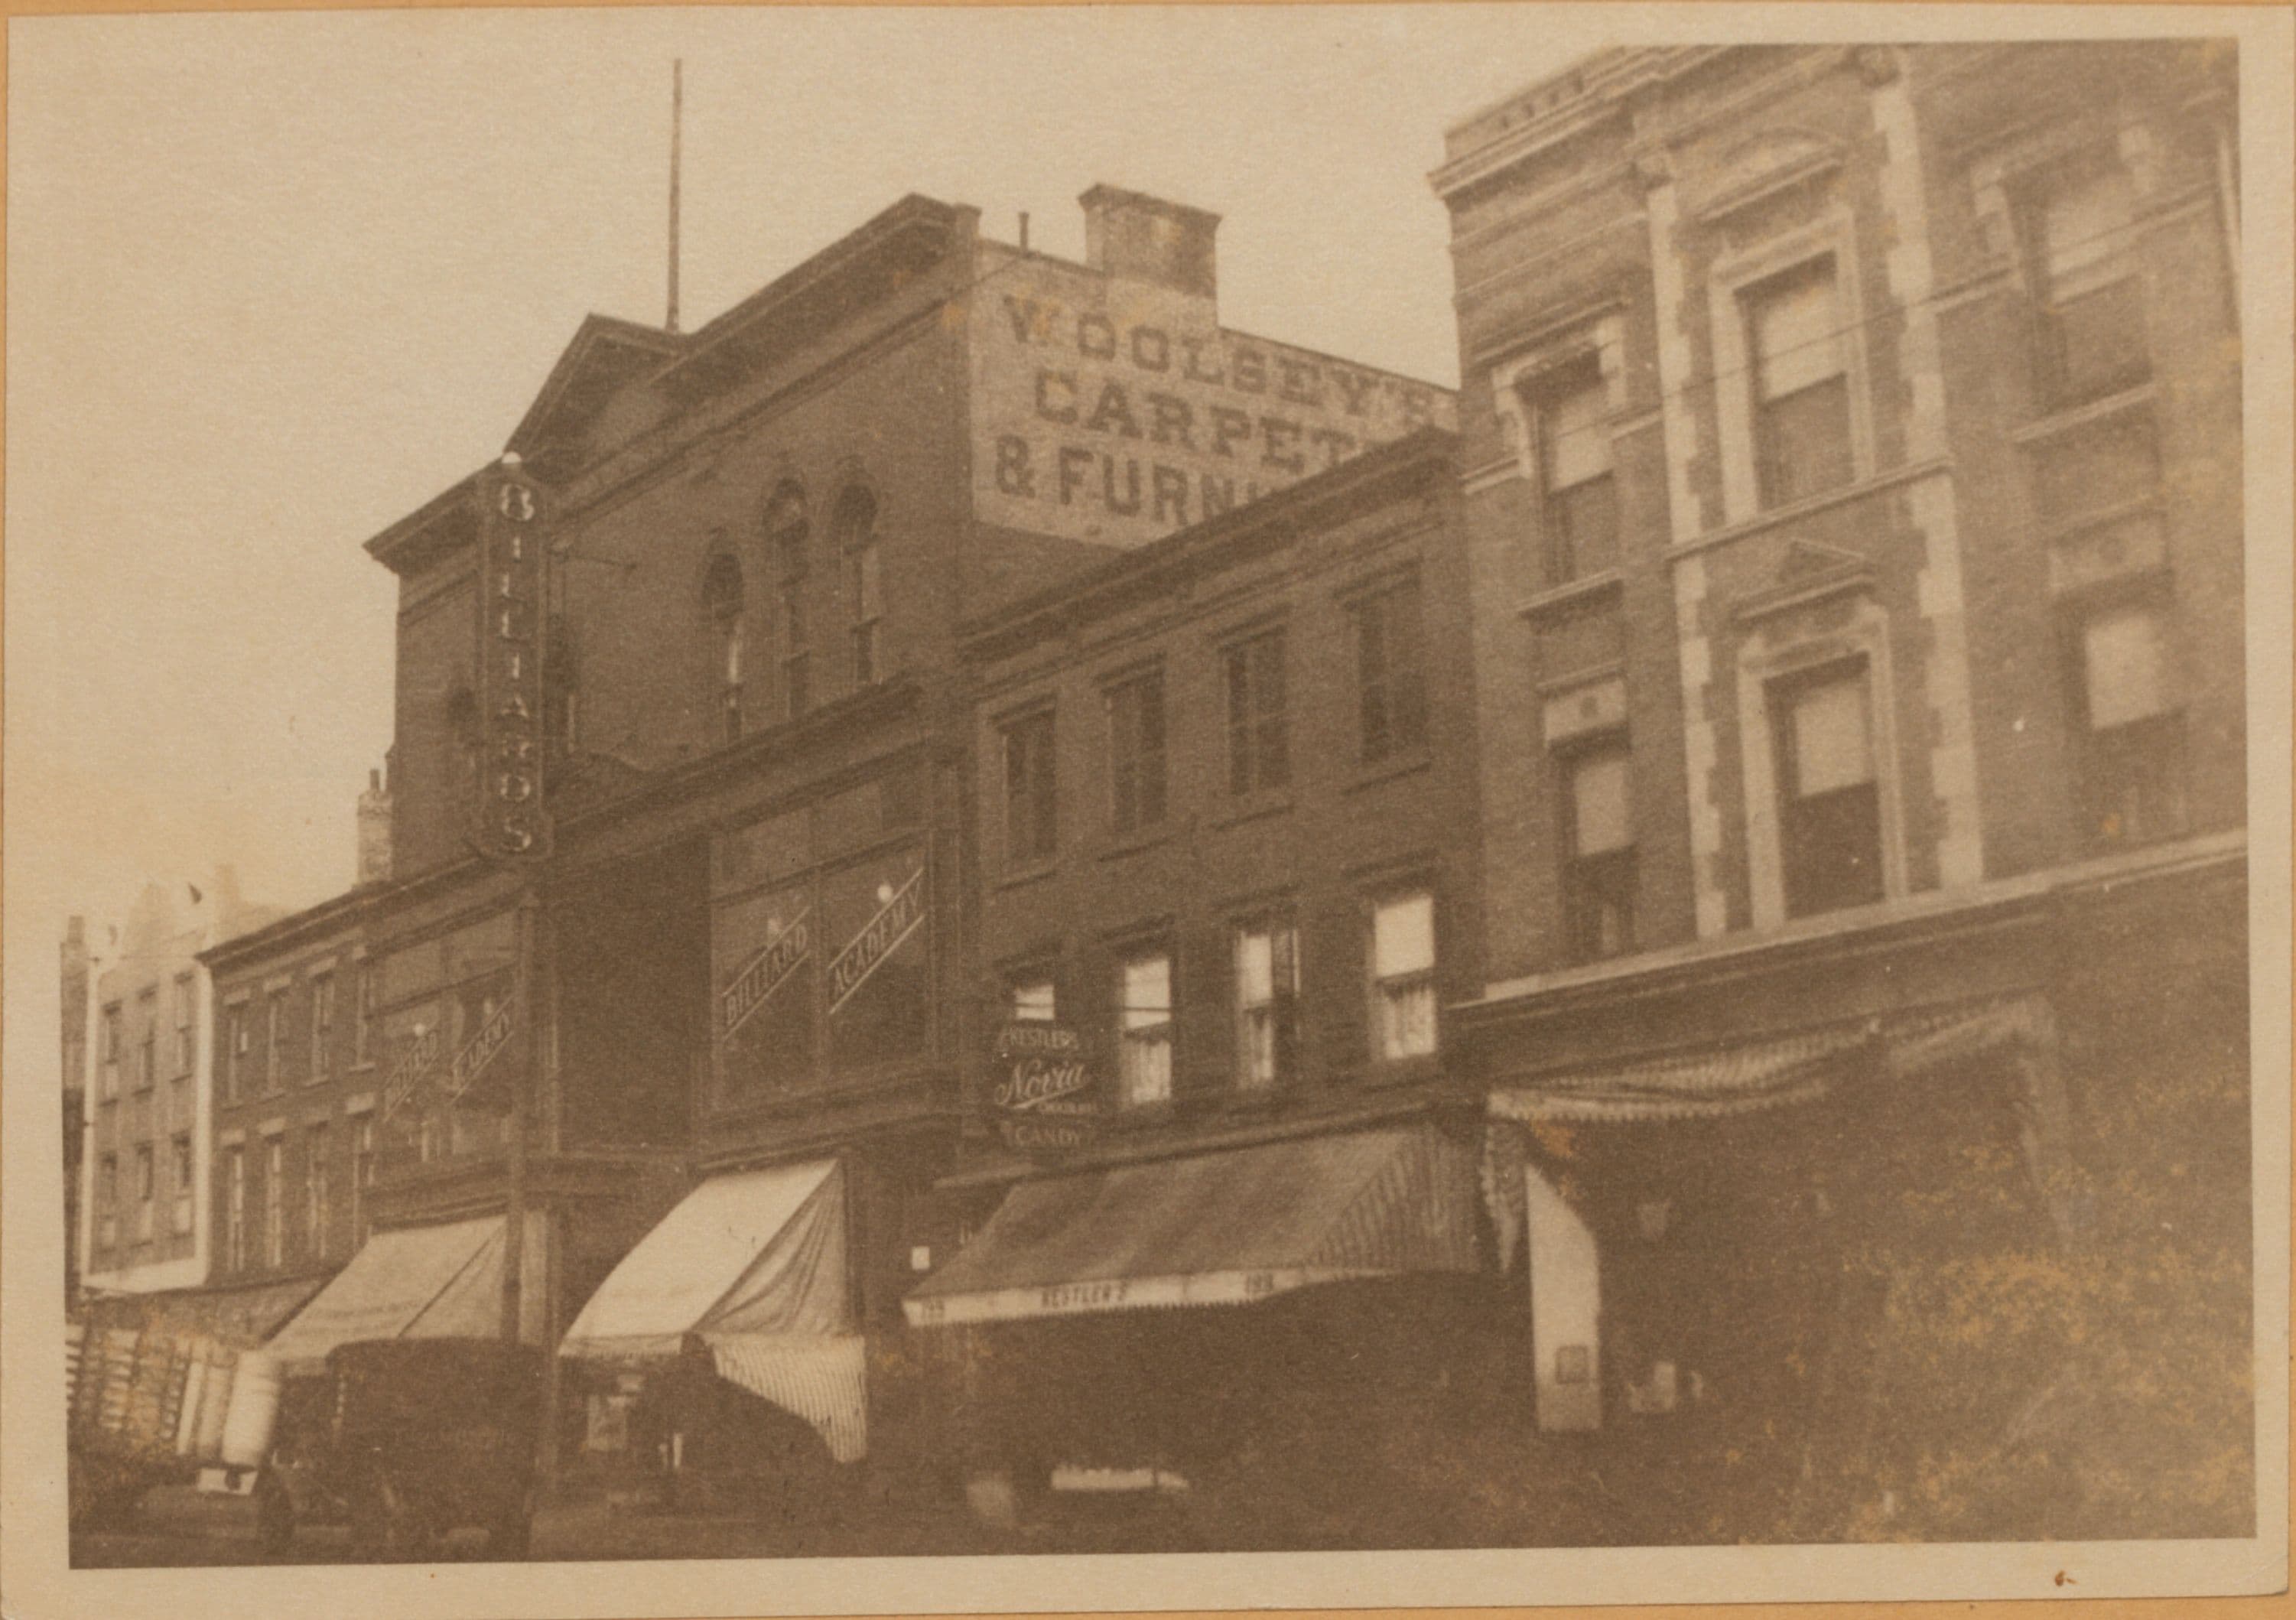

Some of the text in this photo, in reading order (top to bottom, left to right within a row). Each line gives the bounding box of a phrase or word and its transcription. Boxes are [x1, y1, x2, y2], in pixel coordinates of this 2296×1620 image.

[997, 434, 1036, 499] &
[499, 482, 536, 851] BILLIARDS
[833, 879, 921, 1000] ACADEMY
